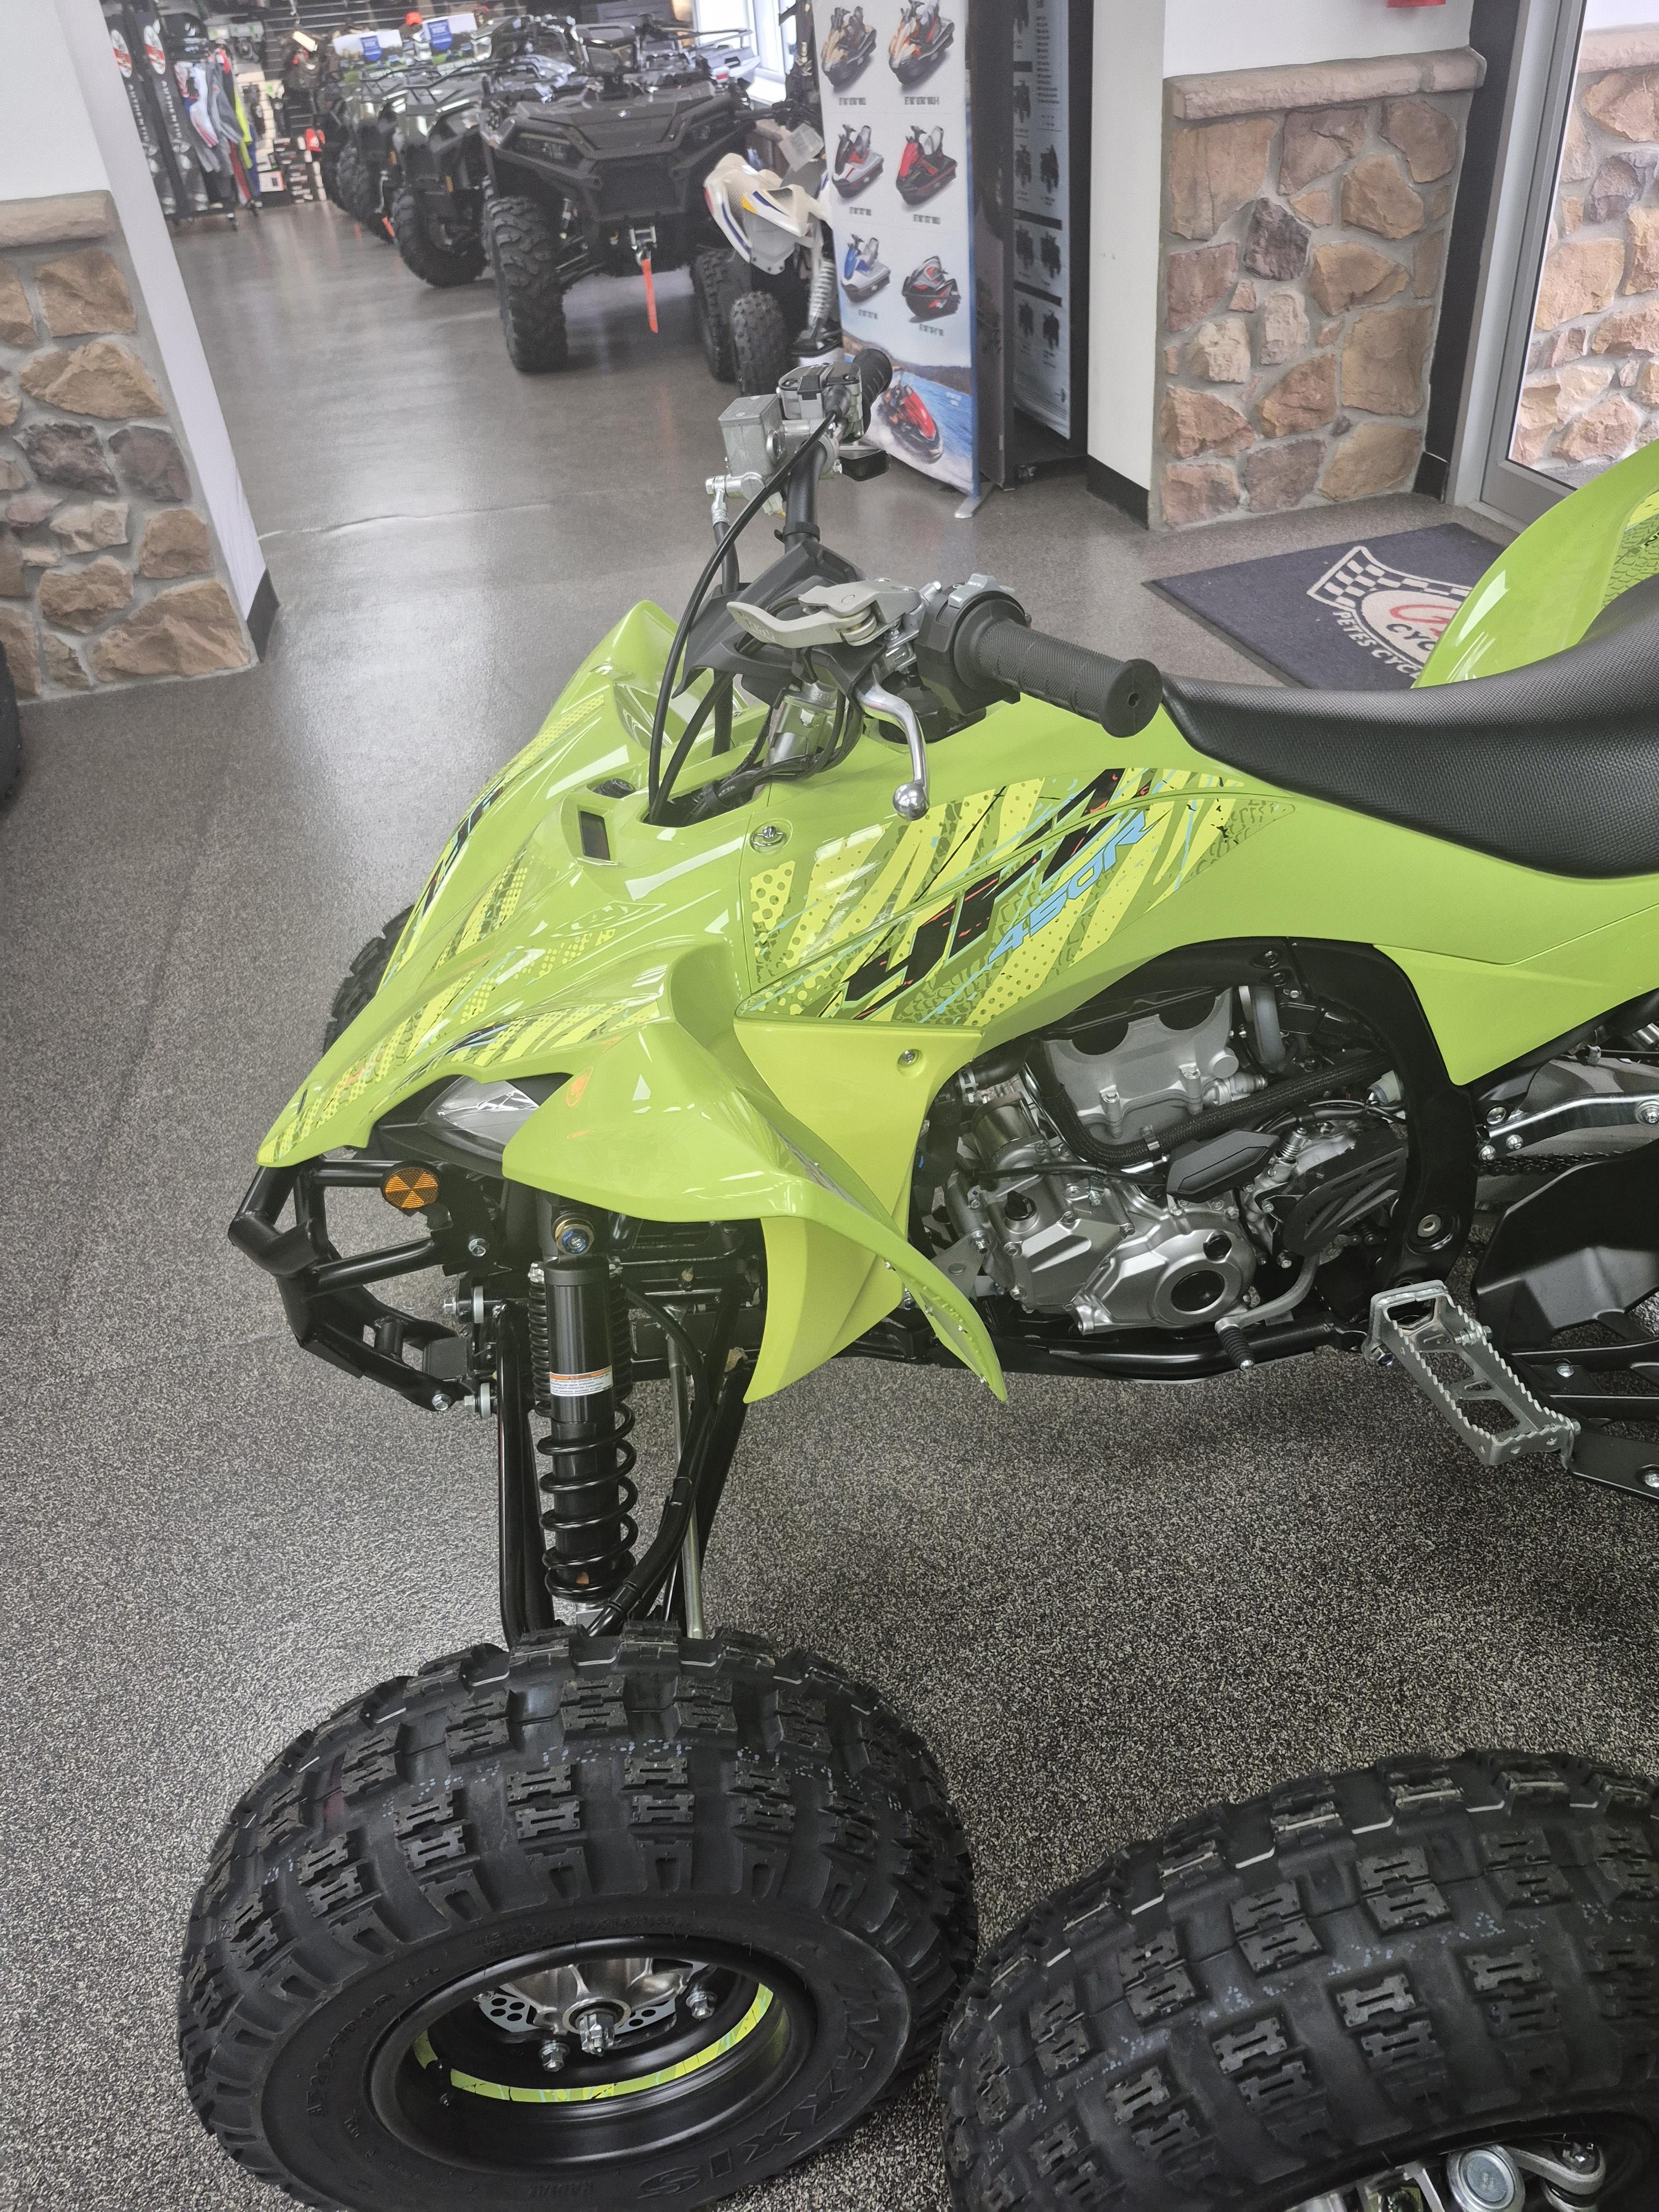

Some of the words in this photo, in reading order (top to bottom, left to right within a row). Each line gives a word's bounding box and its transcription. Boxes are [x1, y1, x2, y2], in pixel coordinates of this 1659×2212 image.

[1332, 612, 1377, 646] PETES
[988, 810, 1172, 964] 450R
[636, 1984, 880, 2199] MAXXIS
